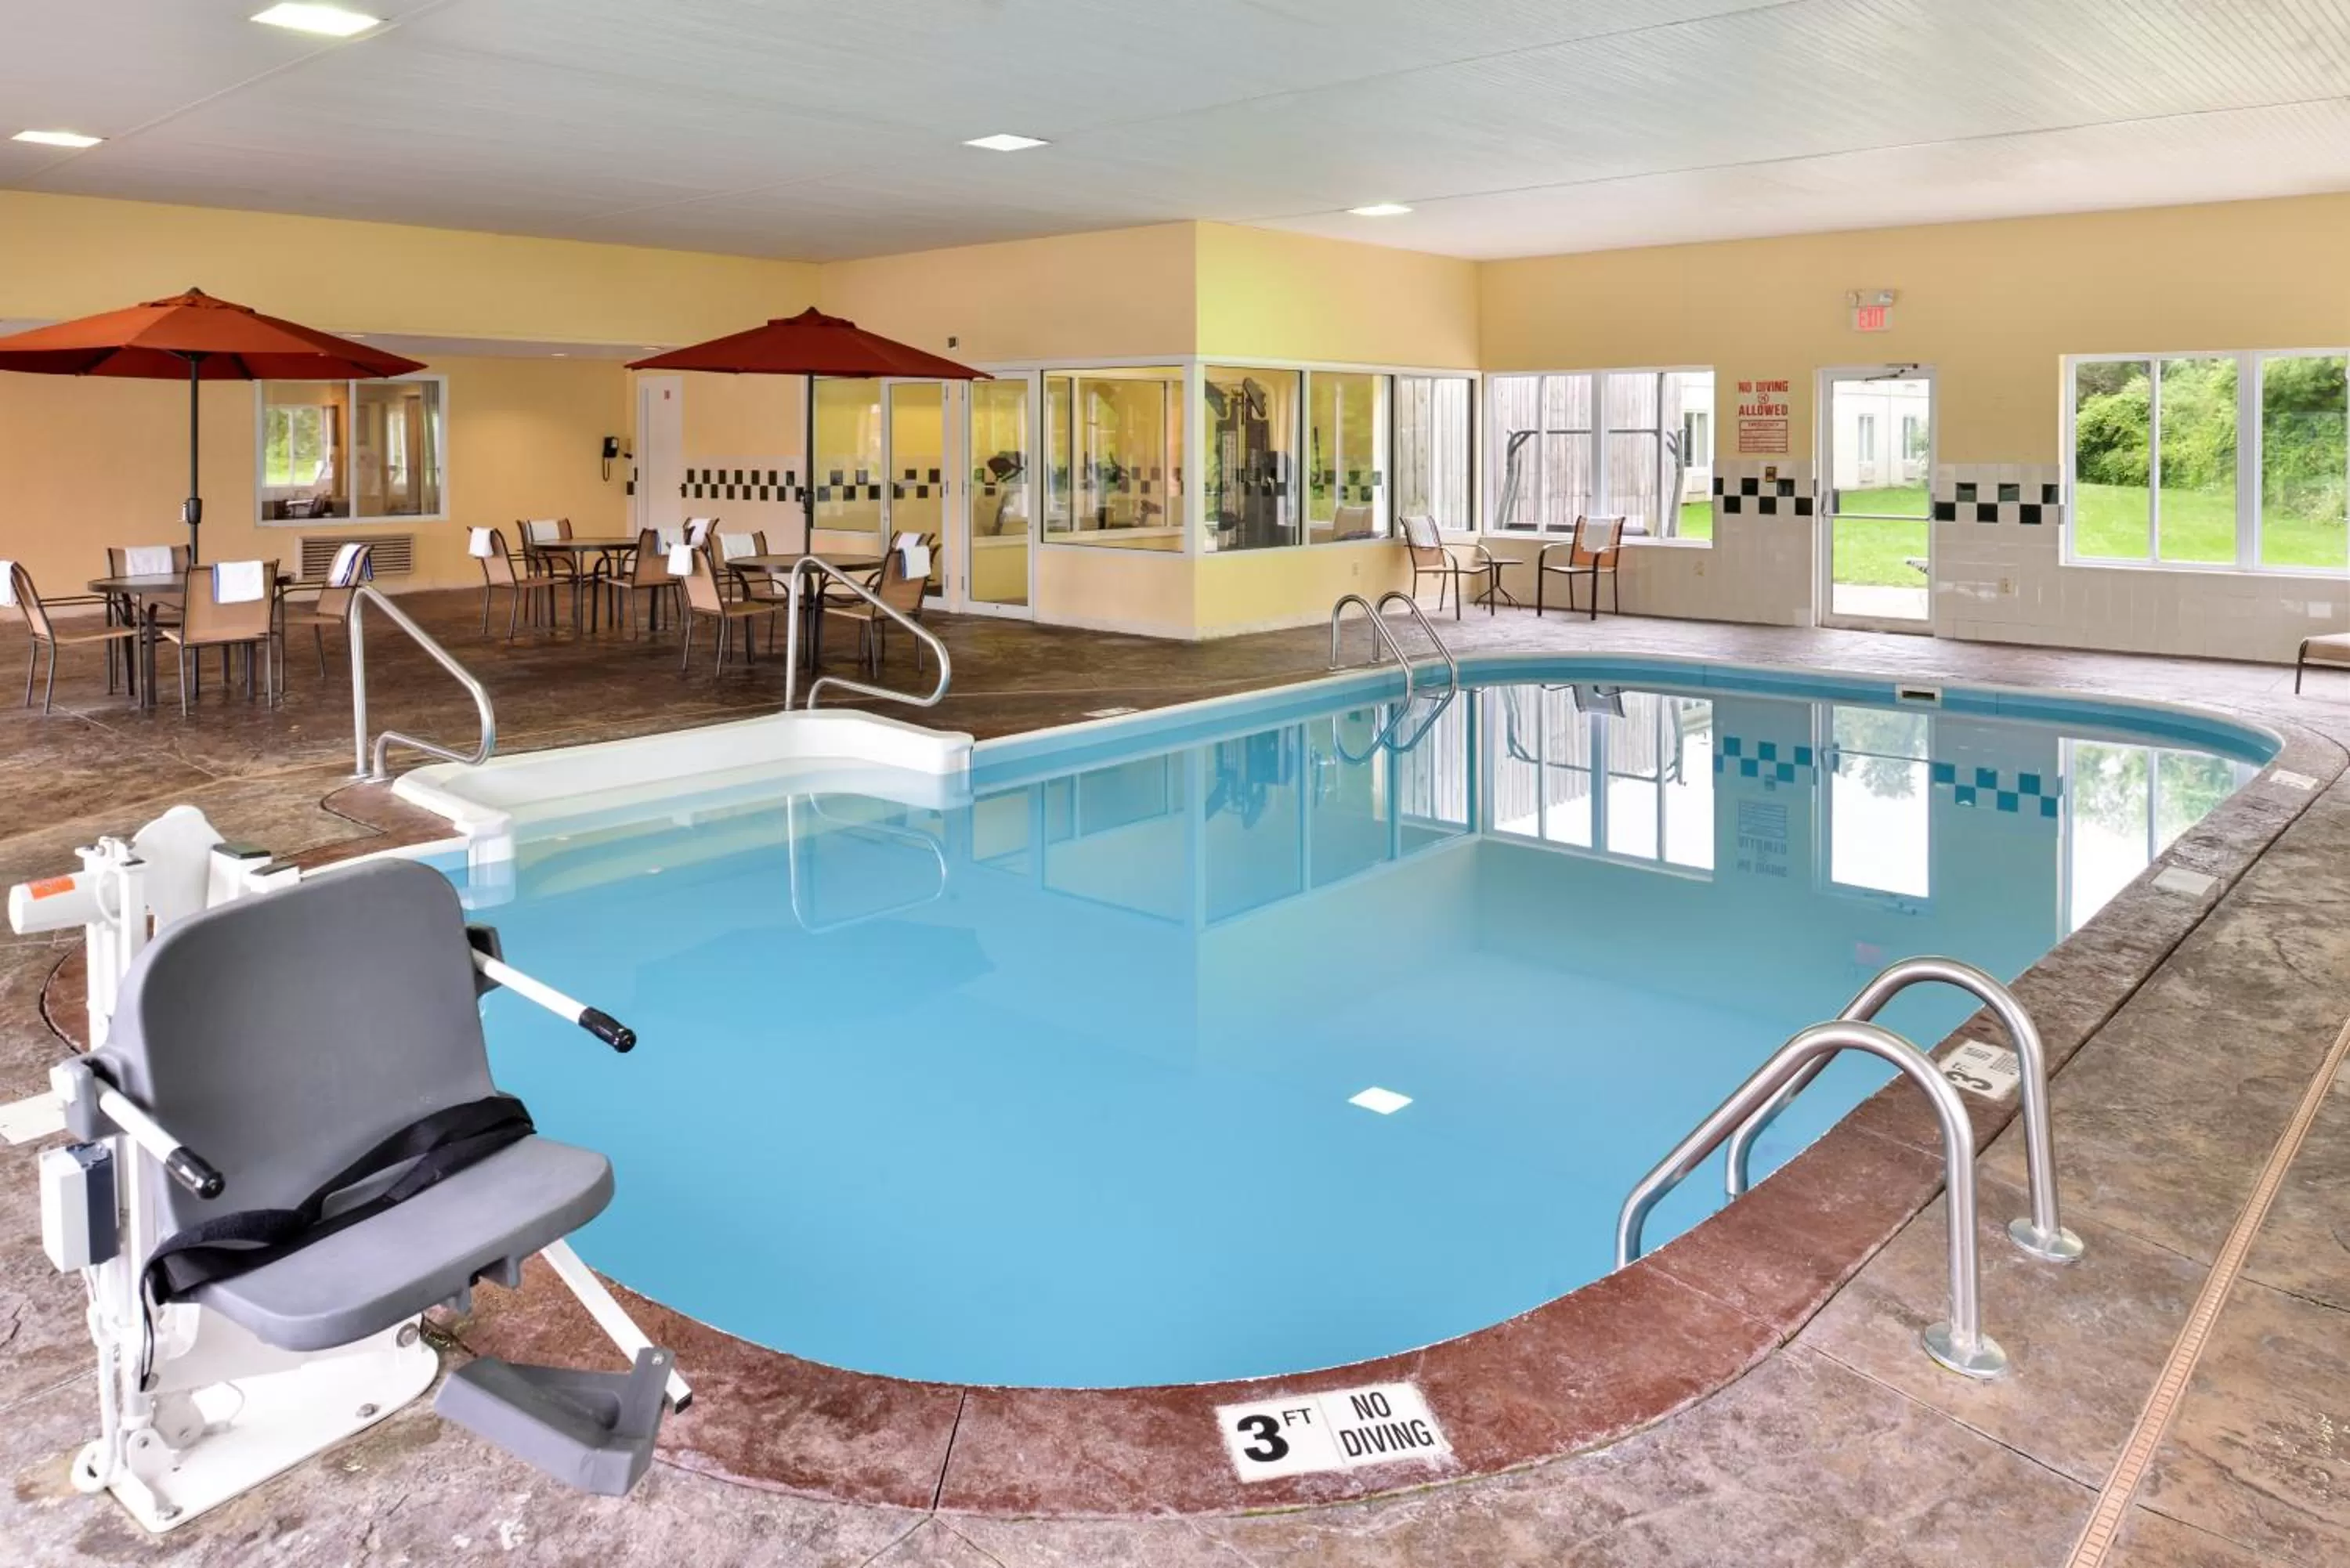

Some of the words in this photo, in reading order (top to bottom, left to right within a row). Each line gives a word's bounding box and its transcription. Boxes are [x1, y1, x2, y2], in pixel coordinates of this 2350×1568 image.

[1858, 306, 1884, 327] EXIT
[1738, 381, 1752, 392] NO
[1755, 381, 1788, 392] DIVING
[1738, 404, 1788, 416] ALLOWED
[1945, 1071, 1993, 1090] 3
[1350, 1391, 1392, 1420] NO
[1237, 1414, 1289, 1462] 3
[1282, 1407, 1311, 1426] FT
[1340, 1418, 1435, 1457] DIVING
